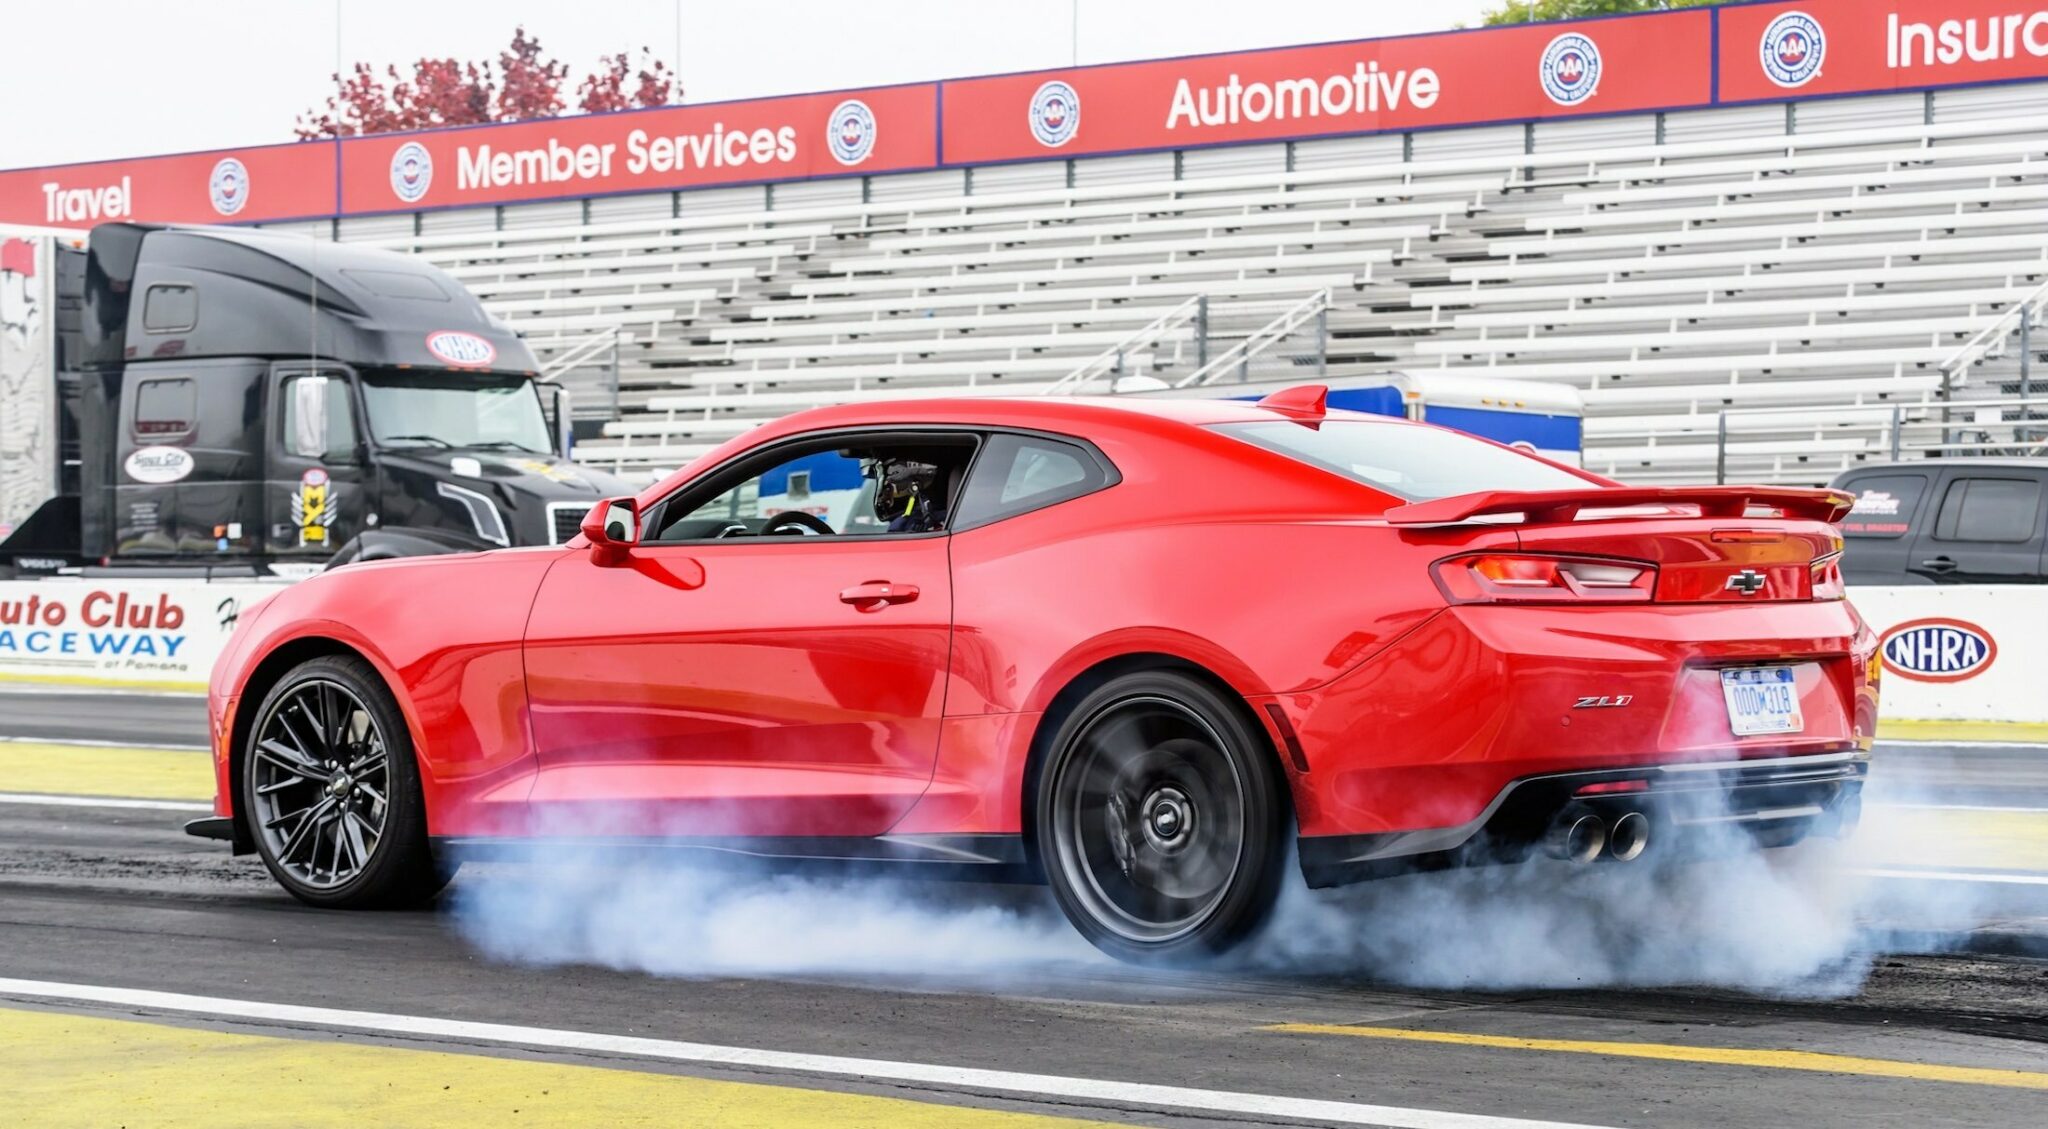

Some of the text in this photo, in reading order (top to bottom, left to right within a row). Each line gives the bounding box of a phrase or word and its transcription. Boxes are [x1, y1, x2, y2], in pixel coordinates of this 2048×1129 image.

[1557, 58, 1584, 77] AAA
[1779, 38, 1806, 57] AAA
[1166, 61, 1440, 129] Automotive
[456, 138, 616, 190] Member
[626, 122, 797, 175] Services
[42, 175, 131, 222] Travel
[434, 334, 490, 362] NHRA
[81, 590, 185, 630] Club
[1895, 628, 1980, 671] NHRA
[1572, 694, 1634, 709] ZL1
